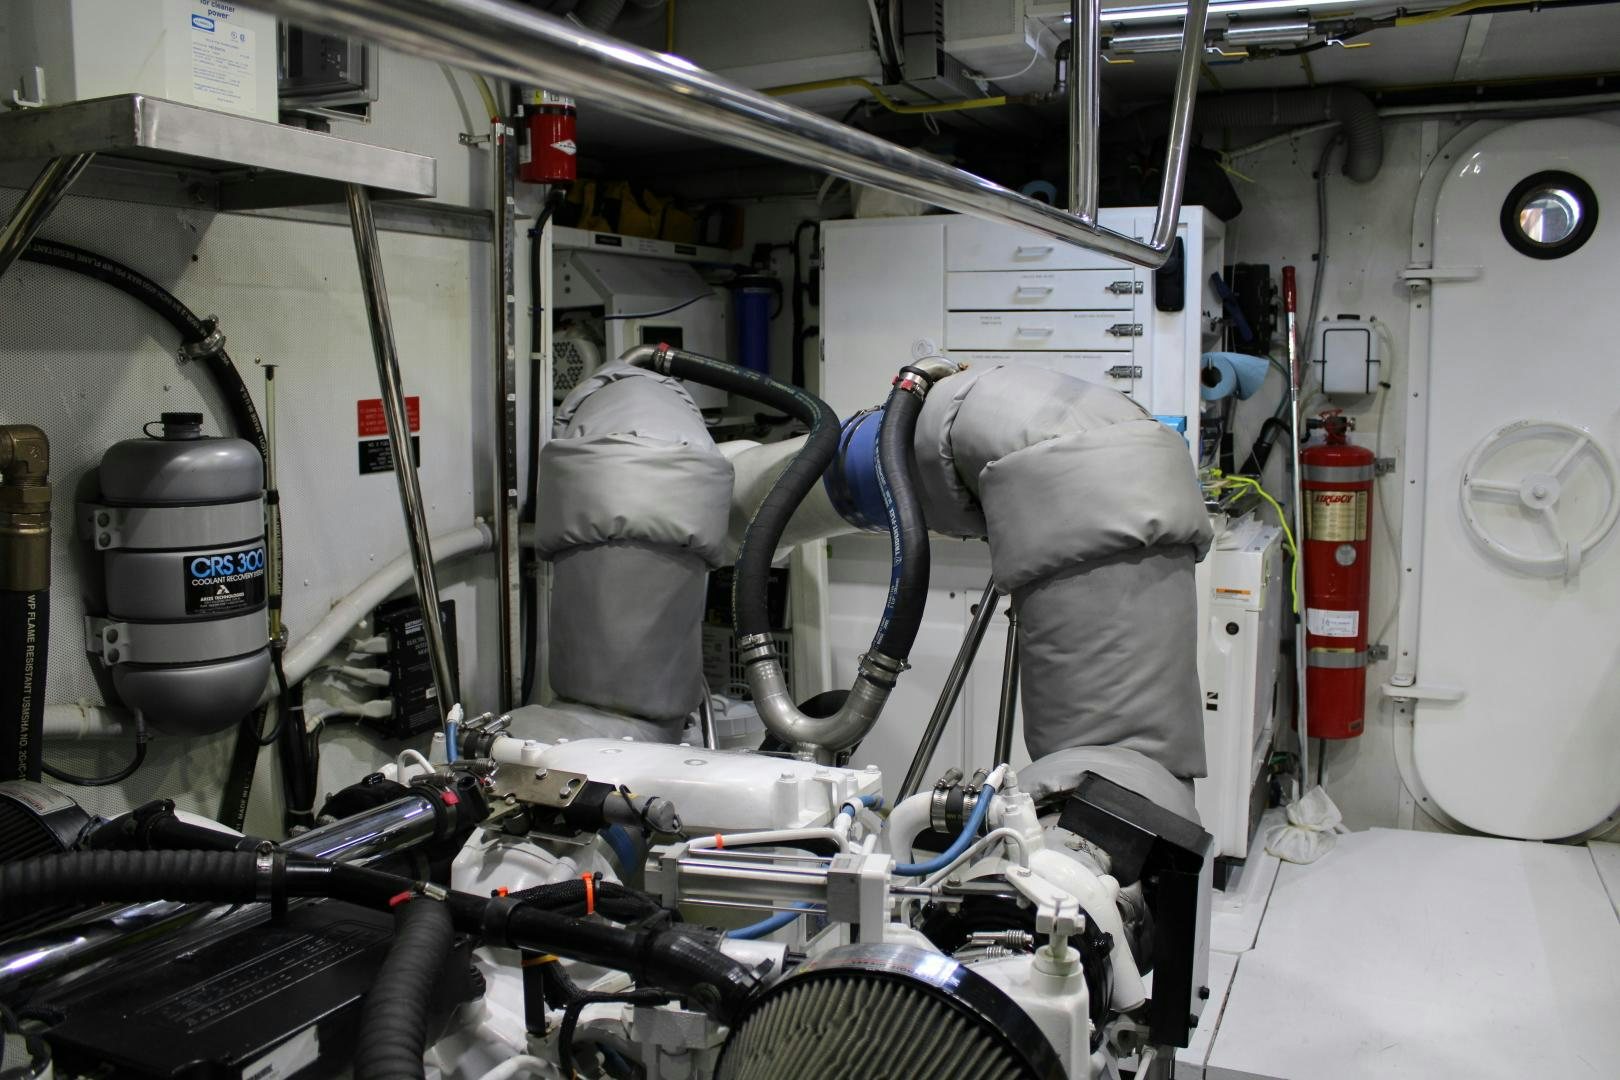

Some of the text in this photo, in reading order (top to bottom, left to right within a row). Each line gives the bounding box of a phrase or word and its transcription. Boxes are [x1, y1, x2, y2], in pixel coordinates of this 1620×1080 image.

[207, 9, 229, 20] power
[1313, 494, 1355, 506] FIREBOY
[190, 548, 264, 578] CRS 300
[191, 576, 226, 586] COOLANT
[226, 572, 254, 583] RECOVERY
[27, 594, 36, 610] WP
[26, 611, 36, 643] FLAME
[23, 645, 35, 694] RESISTANT
